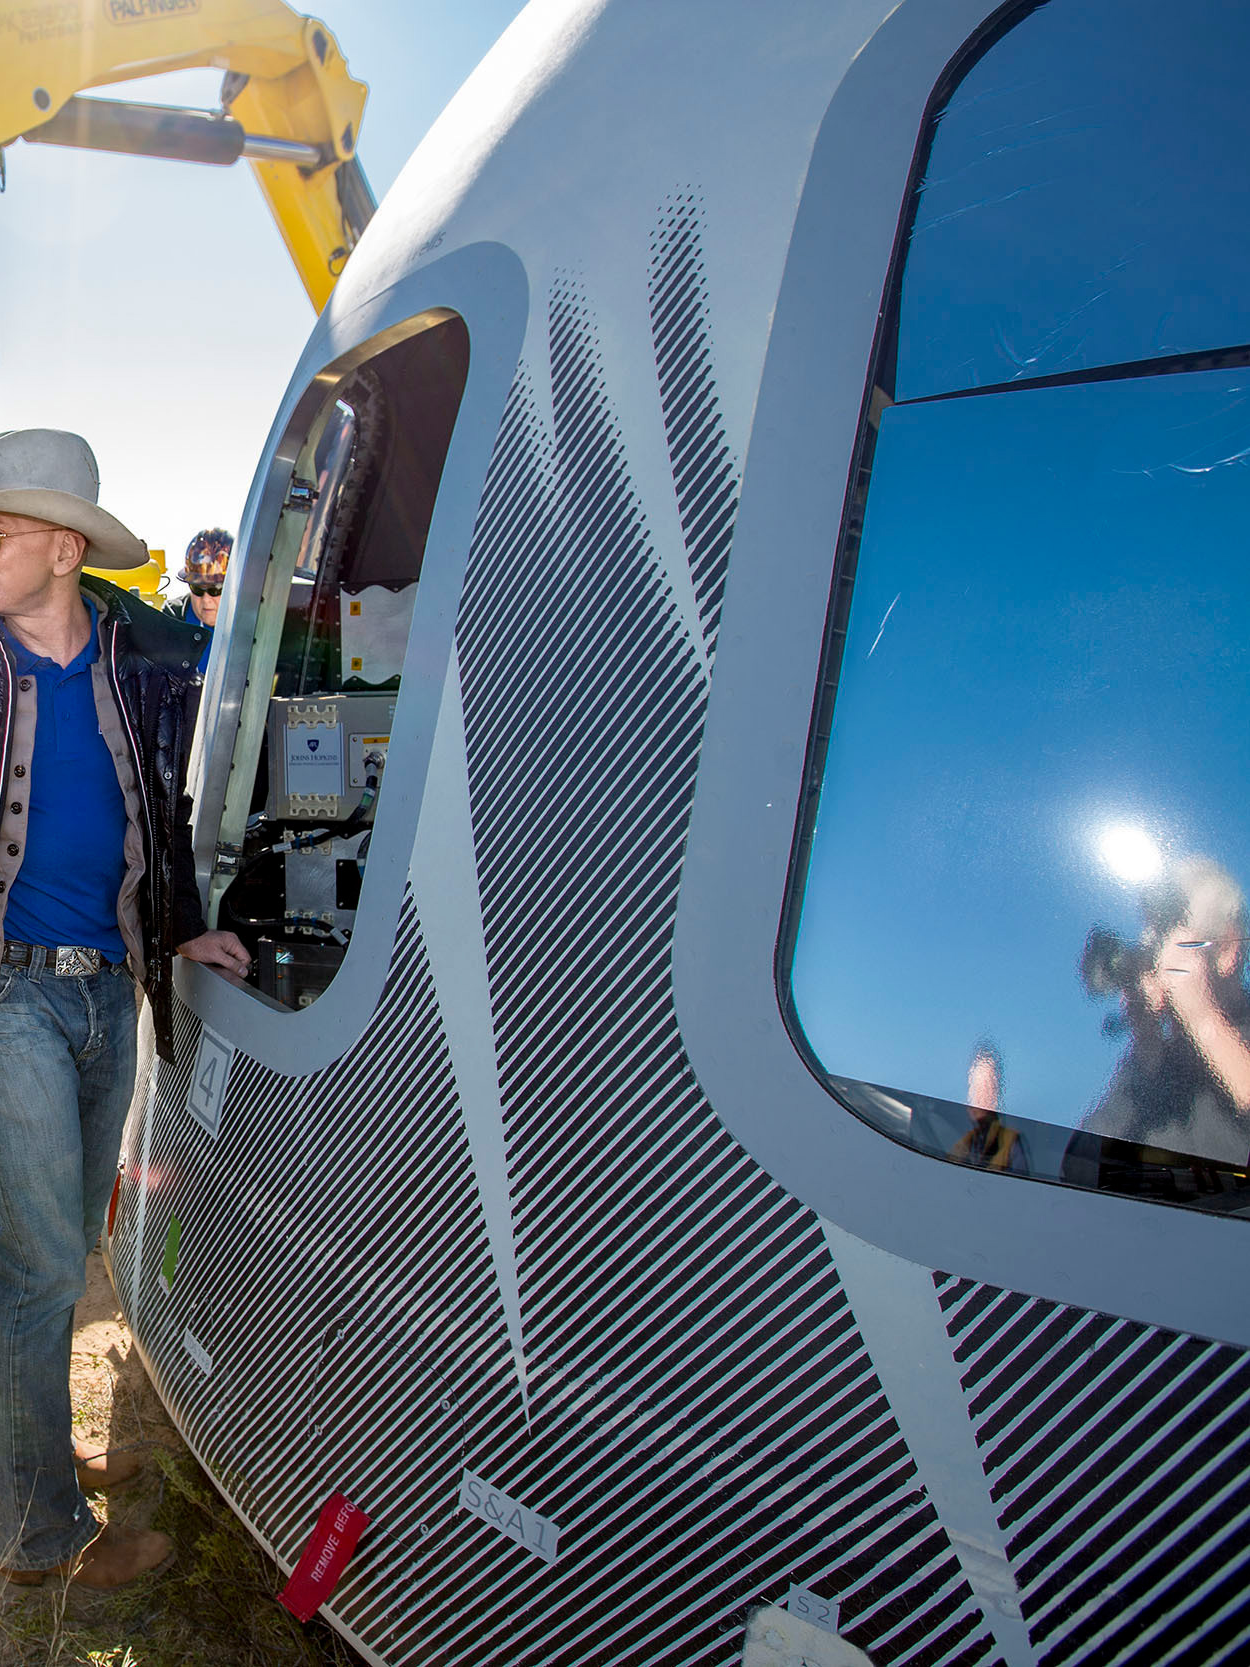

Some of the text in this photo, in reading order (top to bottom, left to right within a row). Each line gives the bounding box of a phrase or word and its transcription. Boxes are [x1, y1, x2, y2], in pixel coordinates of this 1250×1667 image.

[199, 1057, 218, 1107] 4
[465, 1480, 547, 1552] S&A 1
[309, 1533, 340, 1582] REMOVE
